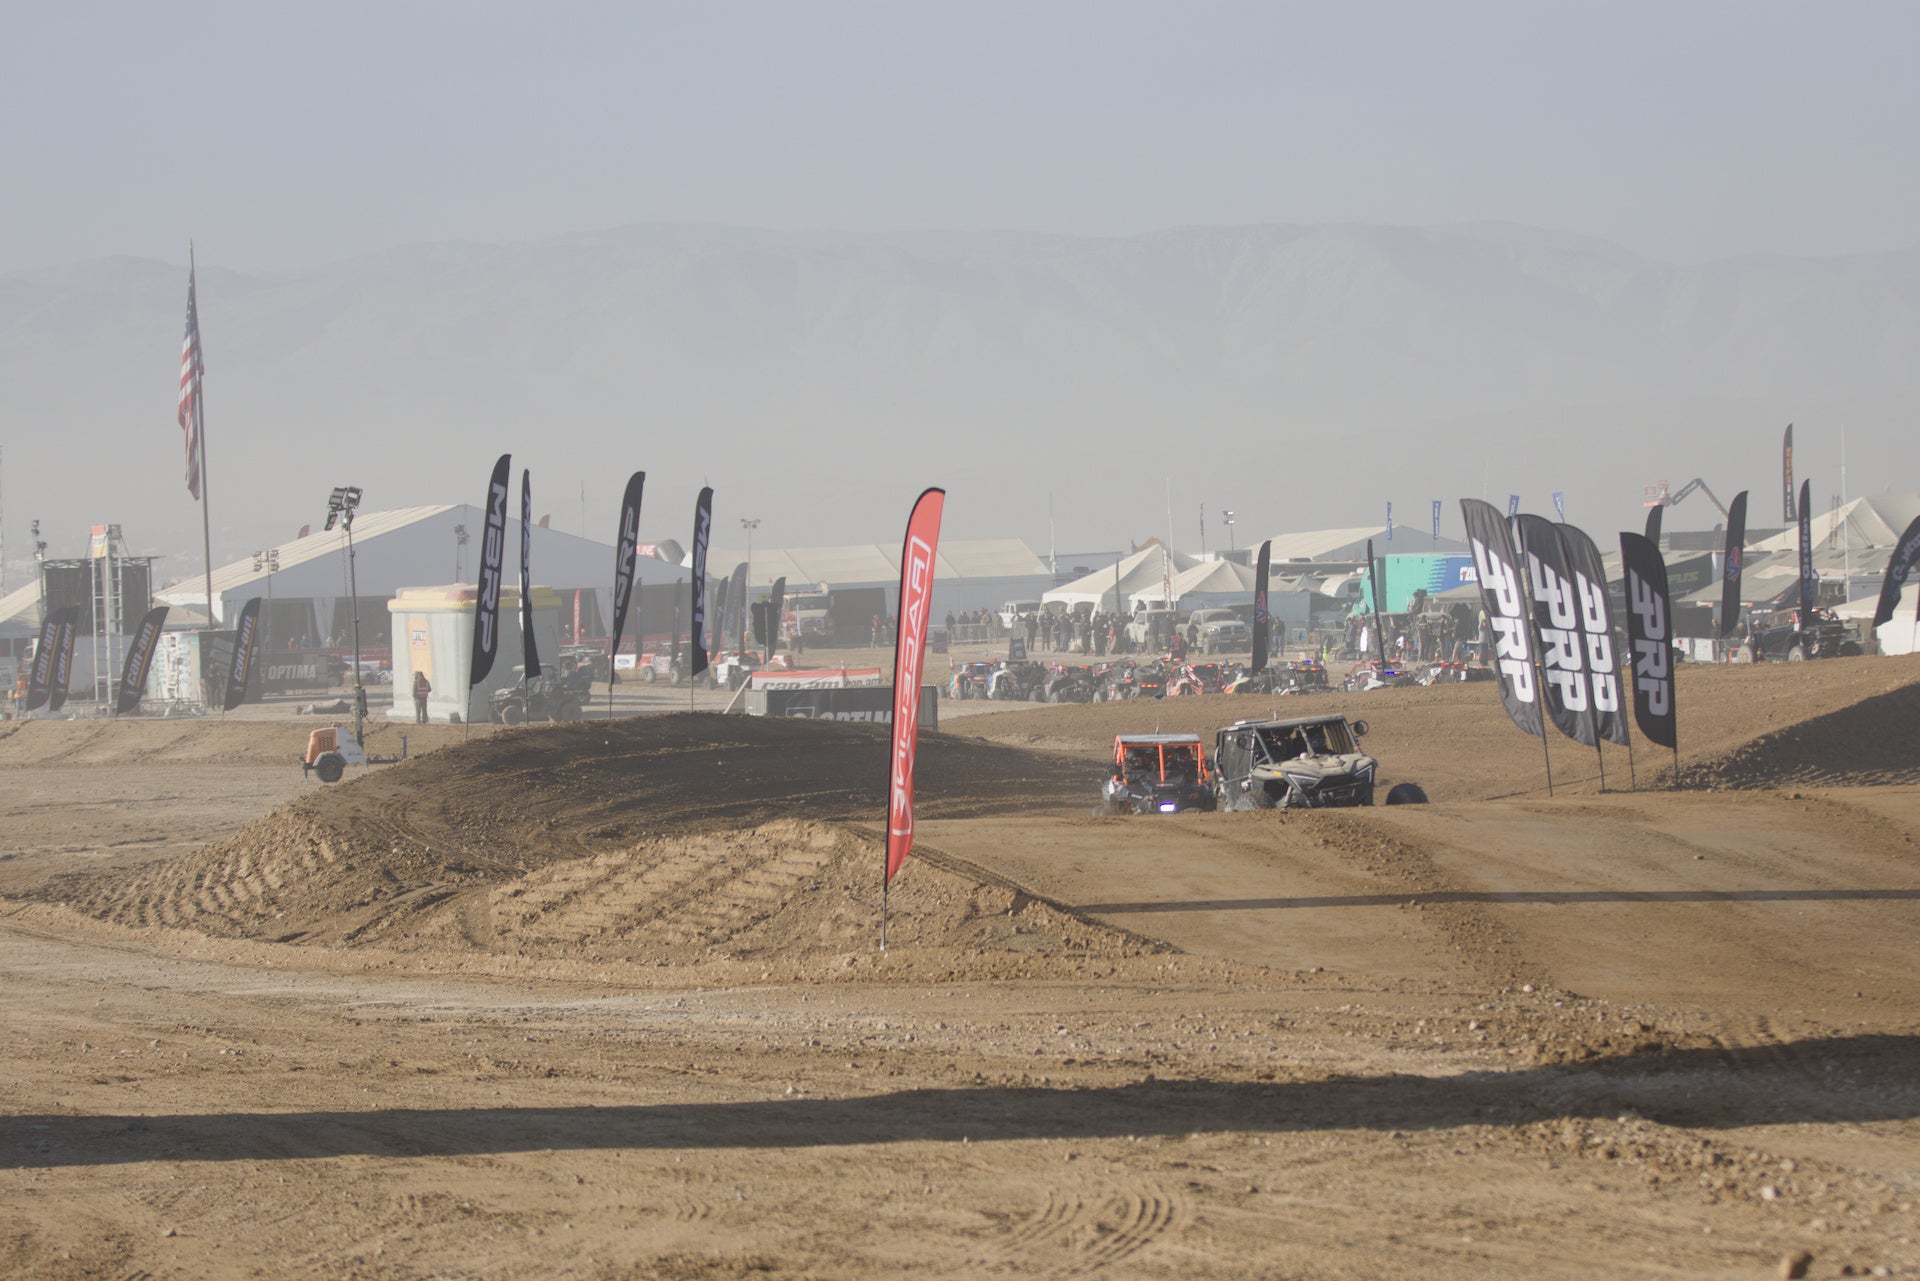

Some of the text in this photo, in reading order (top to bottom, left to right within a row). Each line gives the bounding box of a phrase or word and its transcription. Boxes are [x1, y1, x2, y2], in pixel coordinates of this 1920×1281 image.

[481, 482, 506, 653] MBRP
[1472, 537, 1534, 702] PRP
[1528, 552, 1587, 712] PRP
[1629, 567, 1668, 716] PRP
[268, 664, 316, 680] OPTIMA
